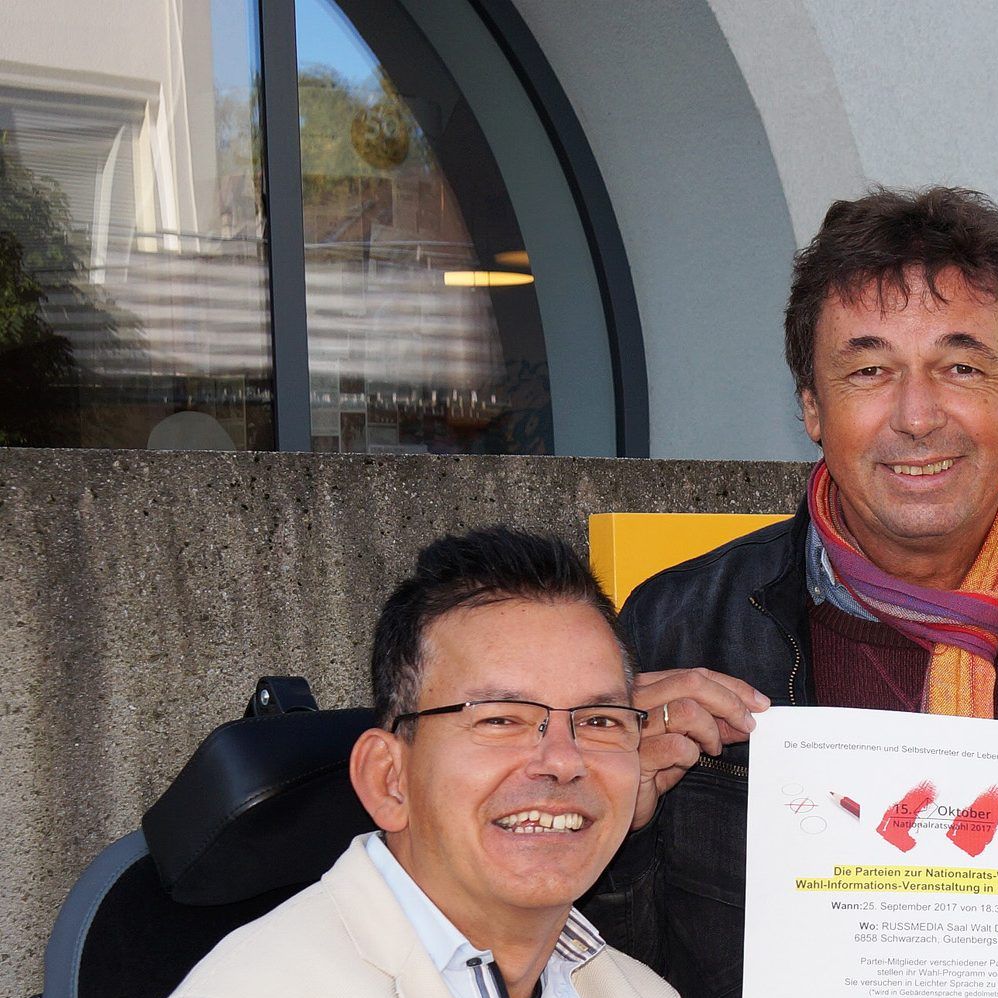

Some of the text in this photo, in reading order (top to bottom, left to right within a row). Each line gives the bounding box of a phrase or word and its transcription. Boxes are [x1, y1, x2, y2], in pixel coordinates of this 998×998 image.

[784, 741, 798, 749] Die
[800, 741, 882, 751] Selbstvertreterinnen
[884, 745, 898, 753] und
[901, 745, 959, 756] Selbstvertreter
[961, 750, 974, 758] der
[894, 804, 991, 820] 15. Oktober
[893, 820, 991, 832] Nationalratswahl 2017
[834, 866, 852, 877] Die
[855, 867, 901, 877] Parteien
[904, 870, 922, 878] zur
[795, 879, 980, 894] Wahl-Informations-Veranstaltung
[983, 883, 994, 893] in
[880, 901, 932, 912] September
[934, 903, 958, 912] 2017
[859, 921, 879, 931] Wo:
[881, 922, 944, 932] RUSSMEDIA
[946, 923, 968, 932] Saal
[971, 923, 992, 933] Walt
[854, 934, 877, 943] 6858
[860, 957, 927, 967] Partei-Mitglieder
[929, 958, 987, 967] verschiedener
[877, 968, 904, 976] stellen
[905, 968, 916, 976] ihr
[918, 968, 986, 979] Wahl-Programm
[844, 977, 858, 986] Sie
[860, 978, 903, 987] versuchen
[905, 979, 912, 987] in
[914, 979, 948, 988] Leichter
[949, 980, 984, 990] Sprache
[986, 981, 996, 989] zu
[899, 989, 963, 998] Gebärdensprache
